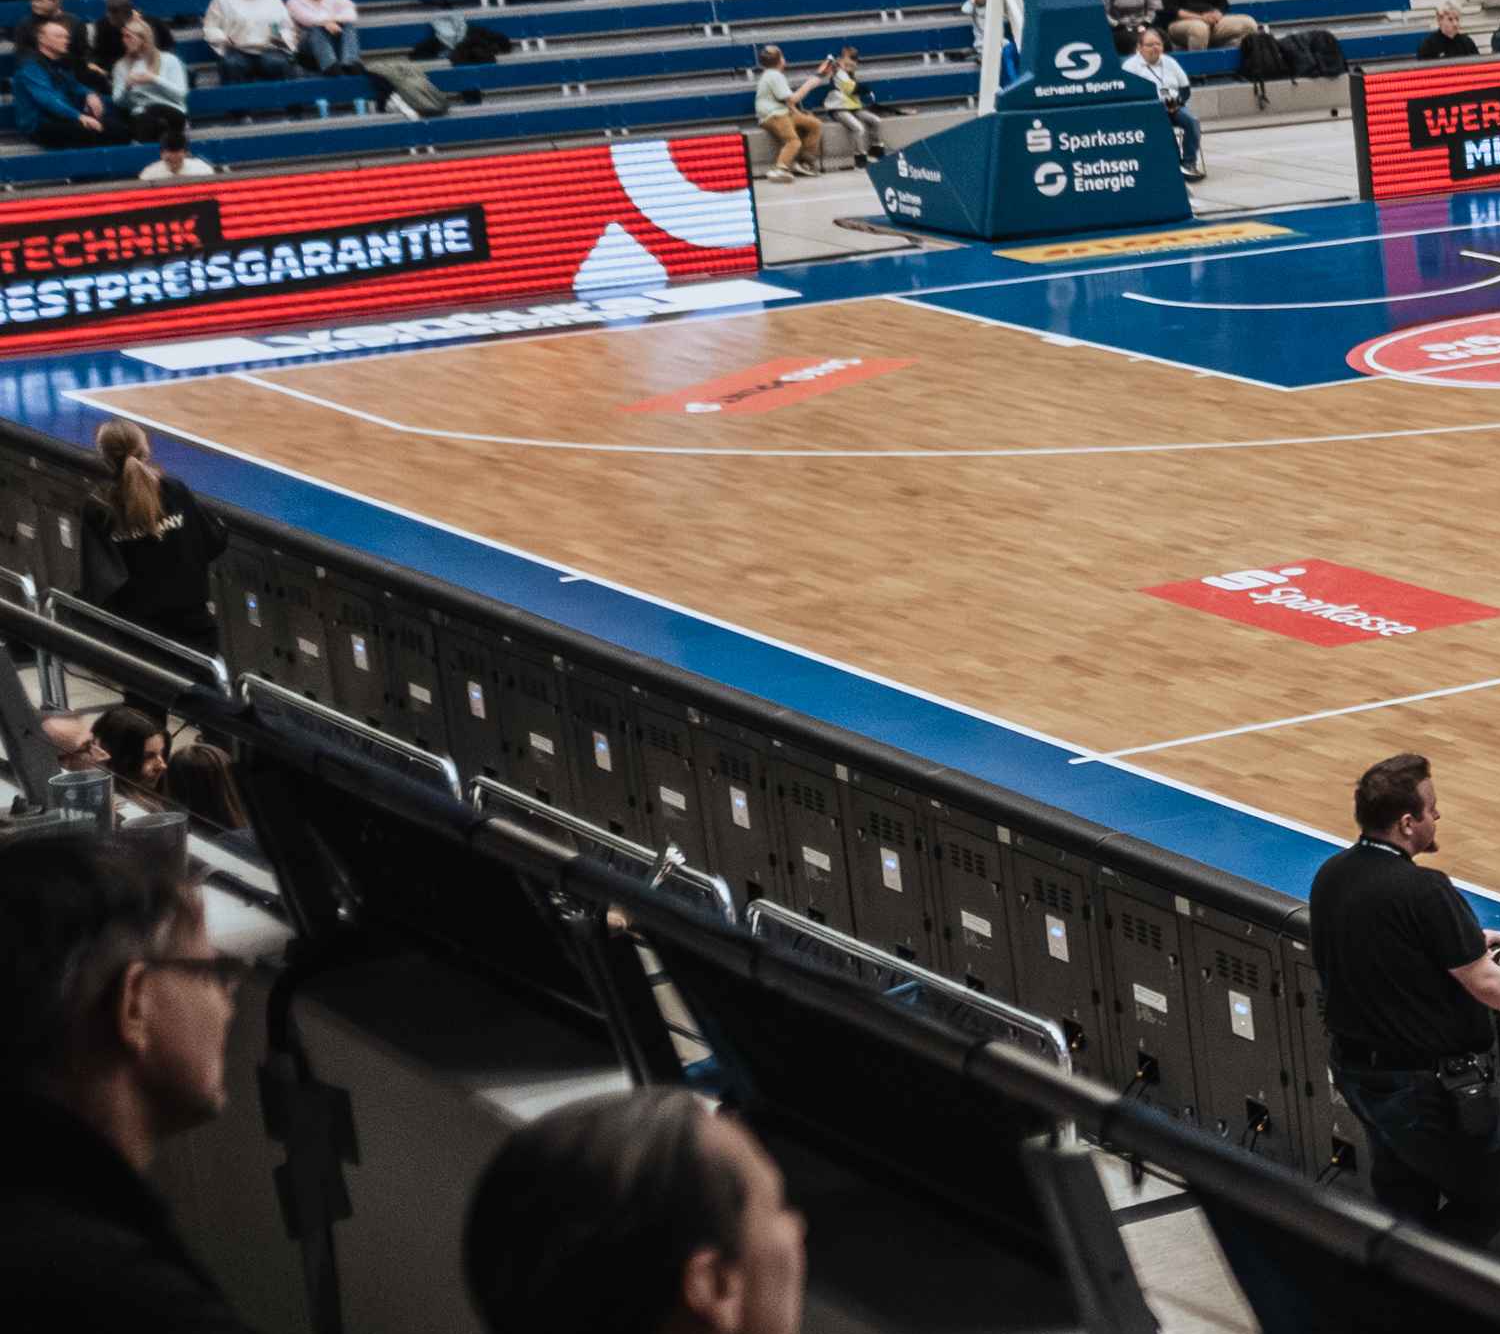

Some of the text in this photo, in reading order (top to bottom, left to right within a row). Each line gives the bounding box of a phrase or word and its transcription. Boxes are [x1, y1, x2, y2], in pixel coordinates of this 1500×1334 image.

[1034, 78, 1126, 97] Schelde Sports
[1058, 128, 1146, 153] Sparkasse
[1072, 157, 1140, 176] Sachsen
[1073, 173, 1137, 193] Energie
[0, 217, 475, 327] ESTPREISGARANTIE
[1248, 586, 1418, 637] Sparkasse
